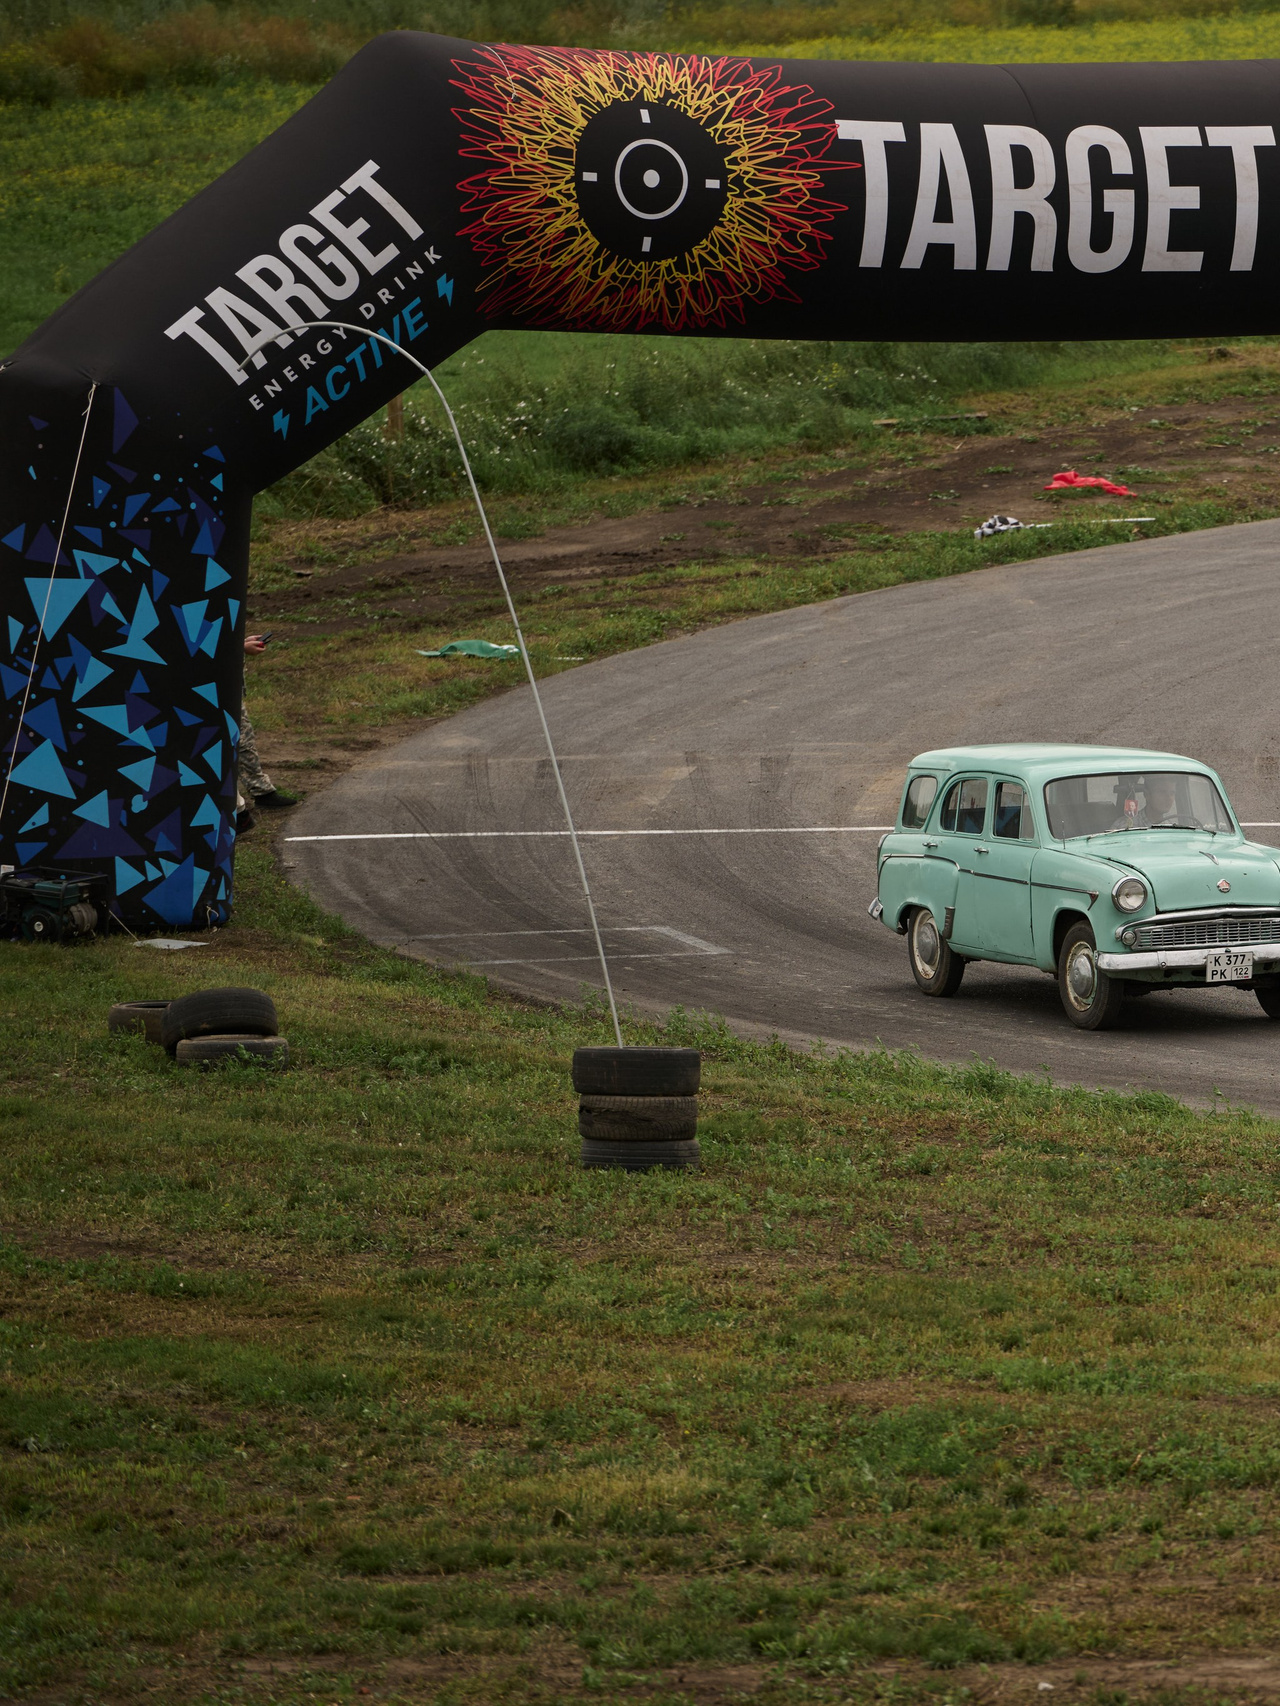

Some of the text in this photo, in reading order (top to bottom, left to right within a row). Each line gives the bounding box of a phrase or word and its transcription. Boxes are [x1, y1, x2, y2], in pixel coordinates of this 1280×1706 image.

[835, 119, 1277, 274] TARGET
[163, 159, 425, 386] TARGET
[248, 245, 442, 411] ENERGY DRINK
[304, 297, 429, 426] ACTIVE
[1225, 954, 1246, 966] 377
[1233, 967, 1249, 976] 122
